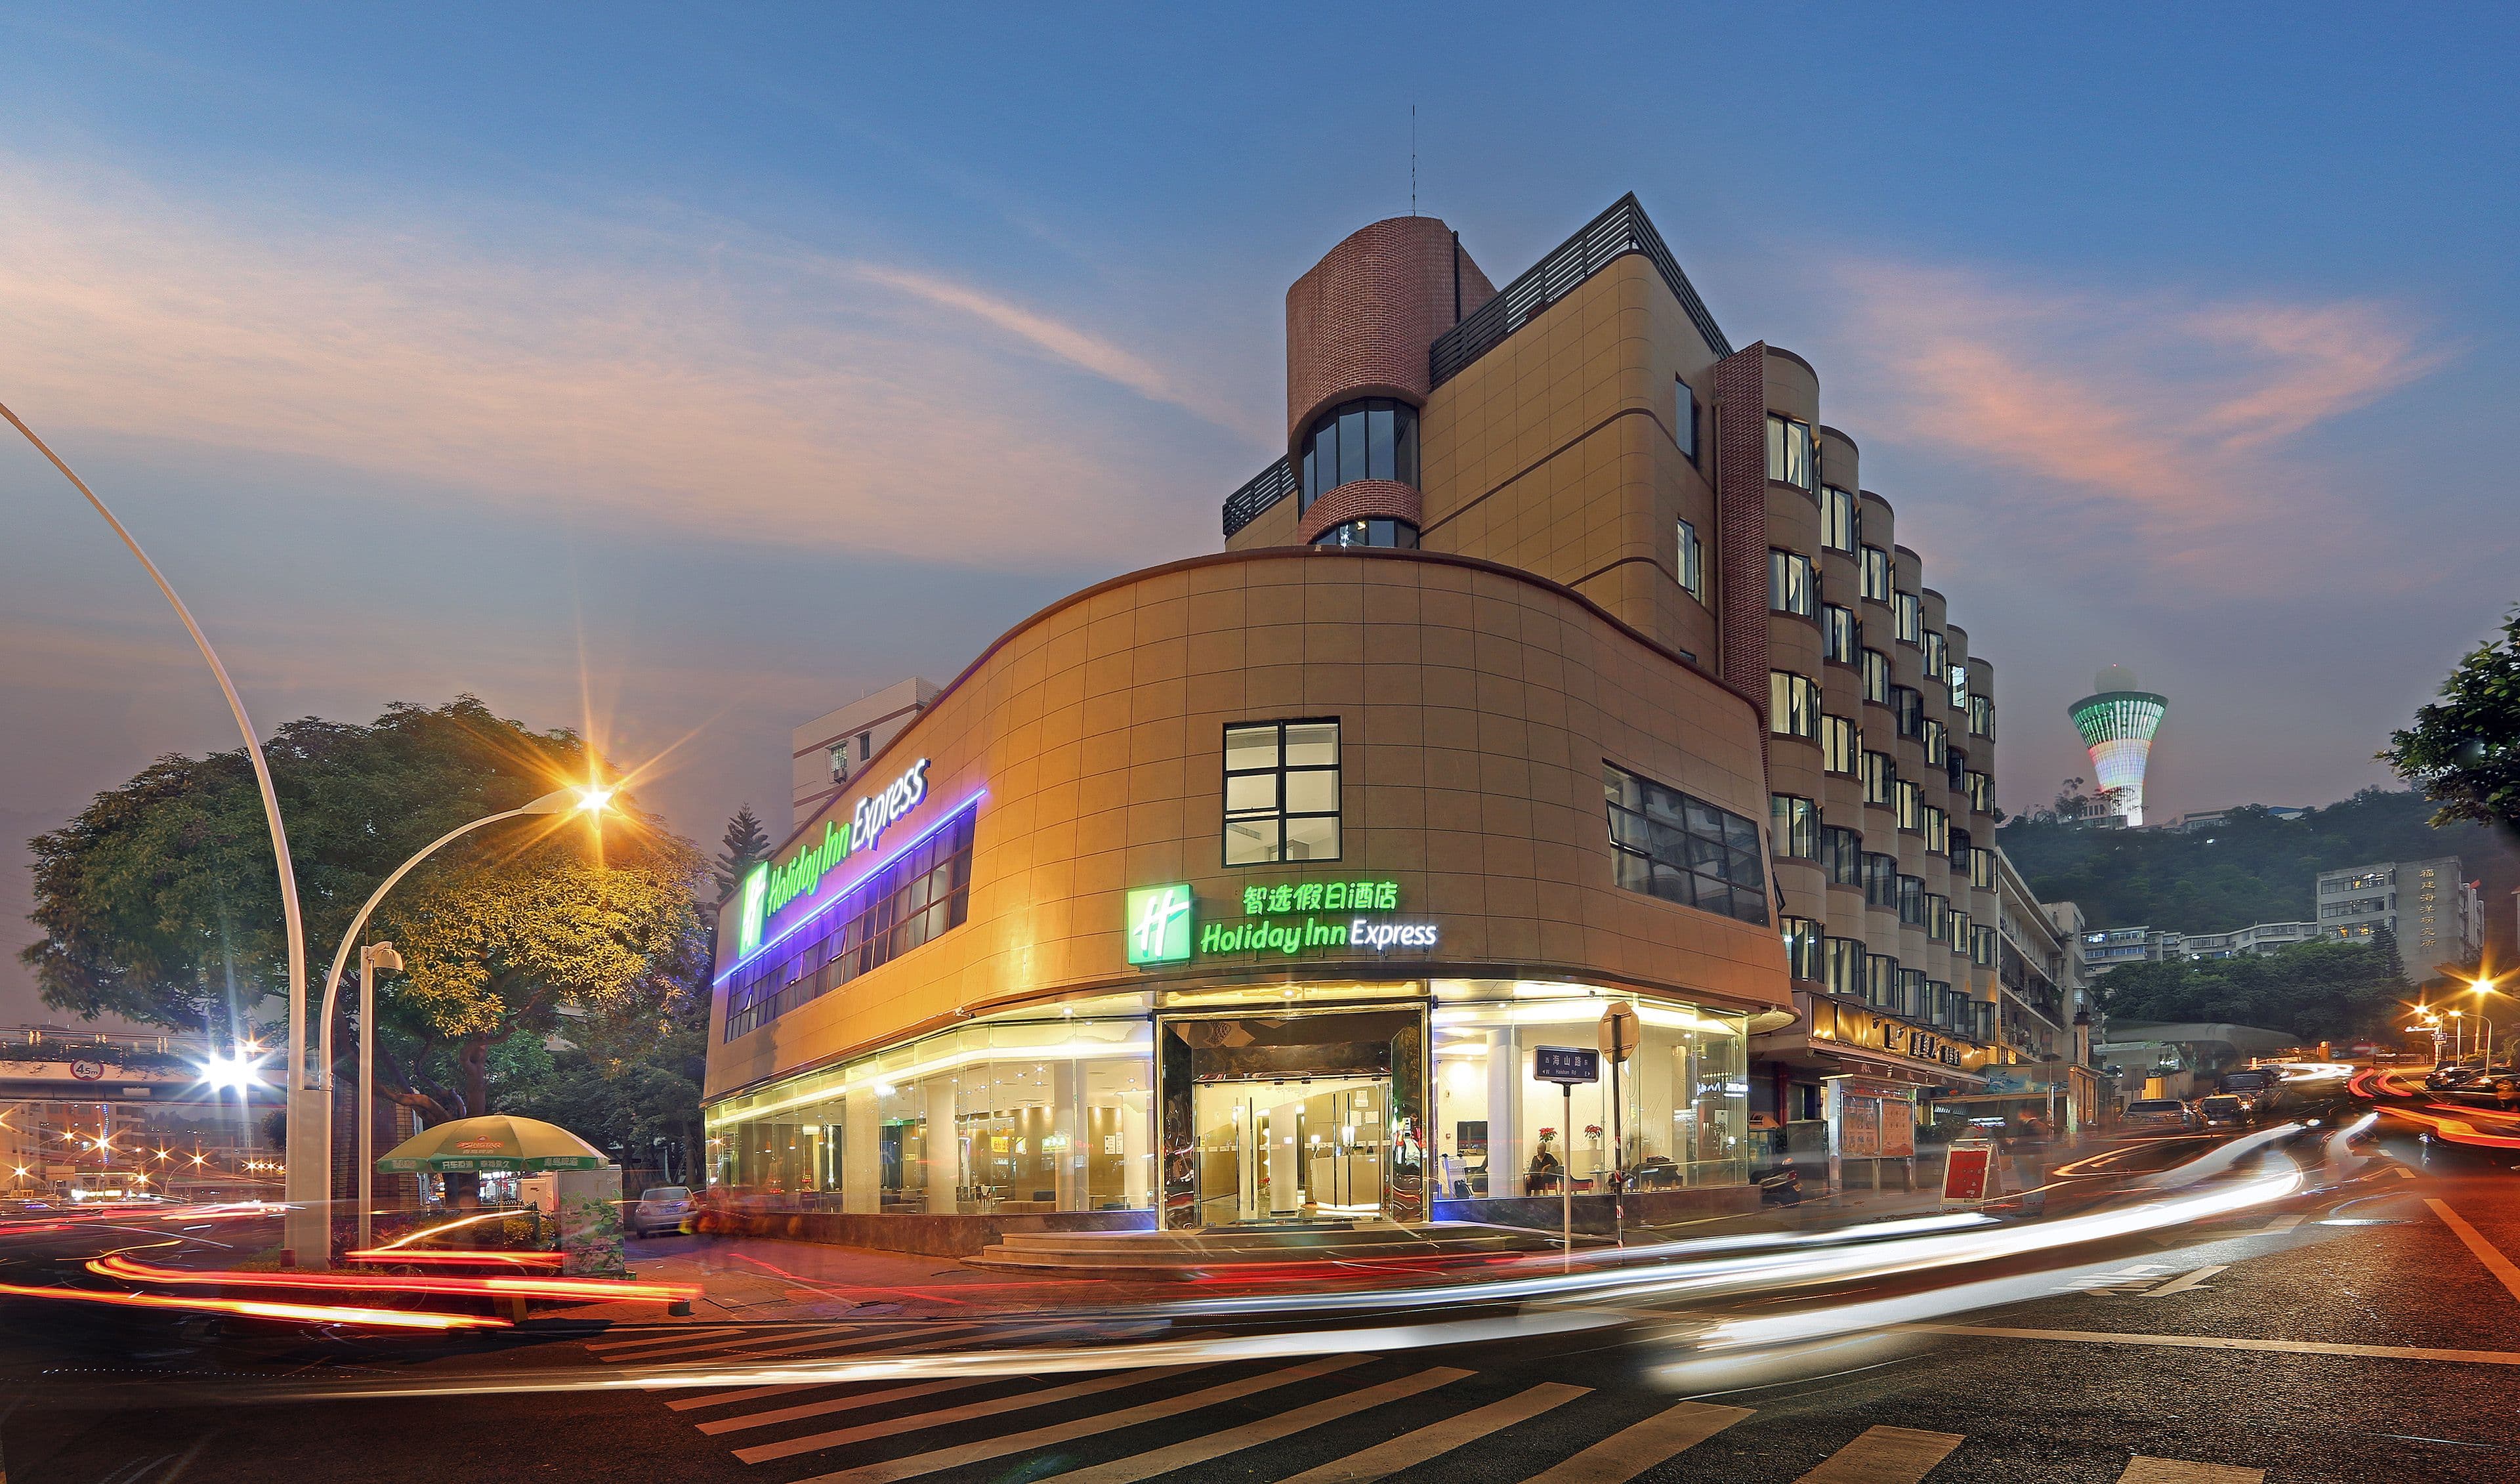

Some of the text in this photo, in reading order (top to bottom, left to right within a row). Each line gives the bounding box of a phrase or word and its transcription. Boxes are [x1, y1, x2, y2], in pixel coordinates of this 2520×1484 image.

[766, 758, 927, 917] Holiday Inn Express
[1243, 881, 1398, 914] 智选假日酒店
[2419, 869, 2436, 946] 福建海洋研究所
[1200, 918, 1437, 954] Holiday Inn Express
[1553, 1055, 1581, 1067] 海山路
